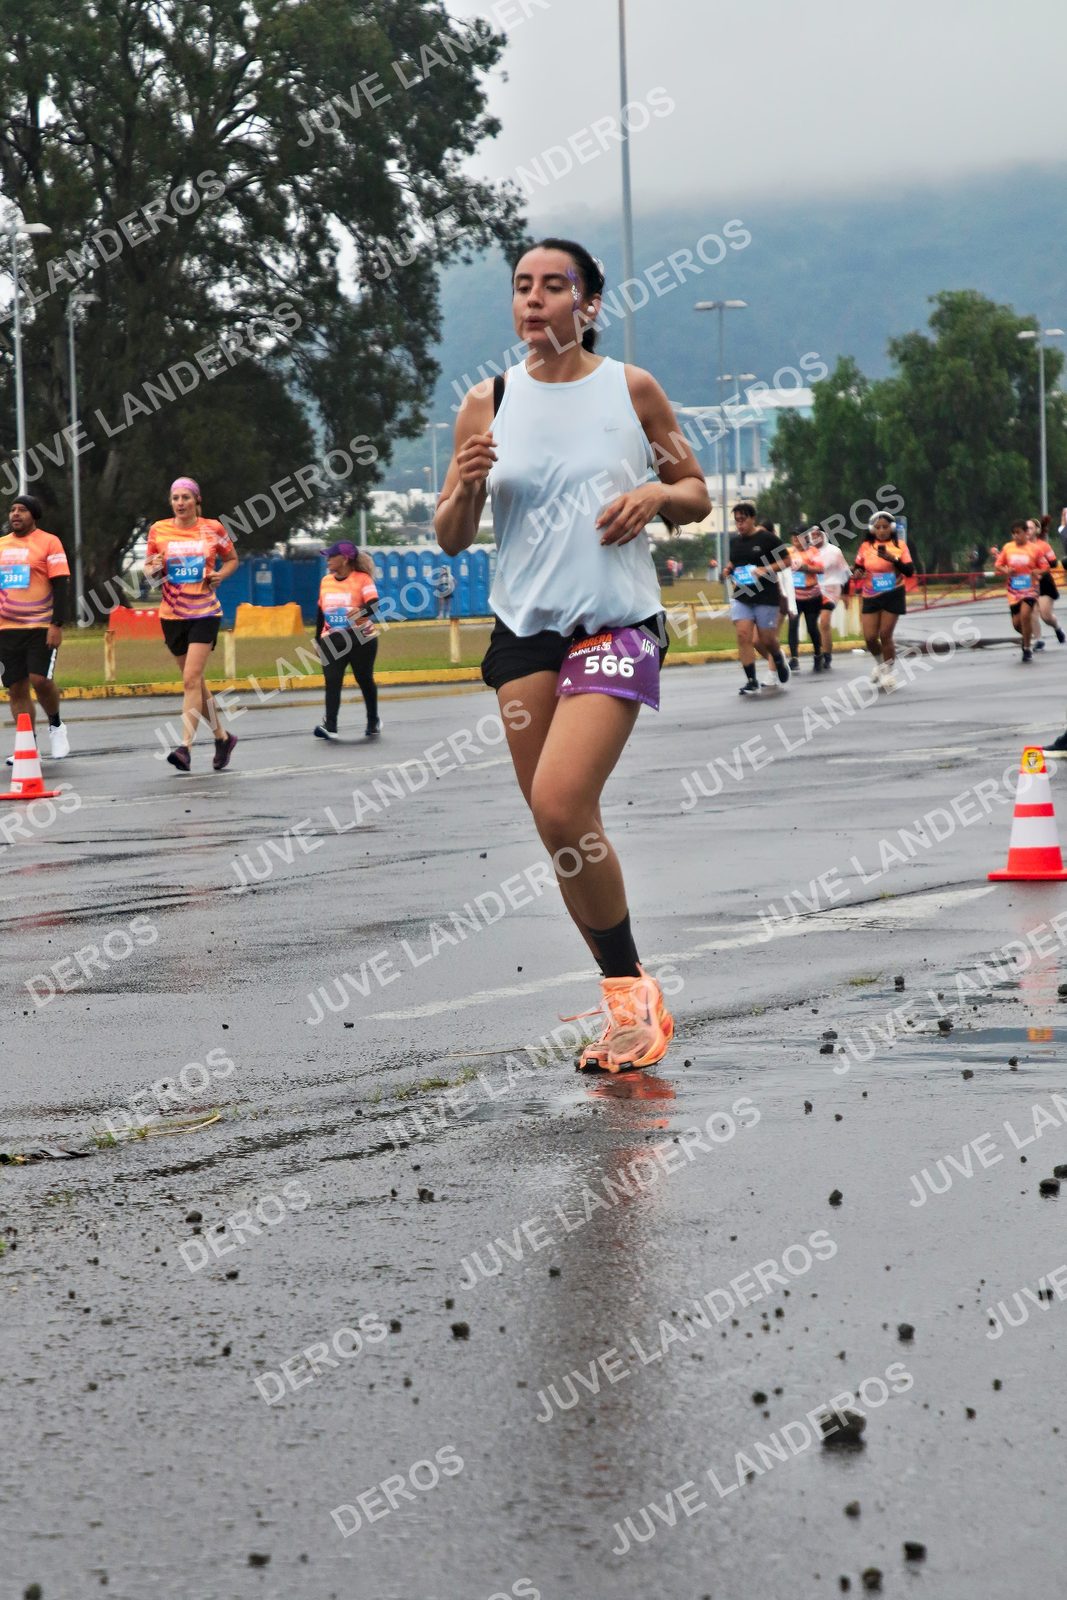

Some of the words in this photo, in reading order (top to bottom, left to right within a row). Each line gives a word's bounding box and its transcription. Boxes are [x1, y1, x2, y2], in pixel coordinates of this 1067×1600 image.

[175, 567, 199, 576] 2819
[4, 574, 23, 583] 2331
[584, 655, 635, 678] 566
